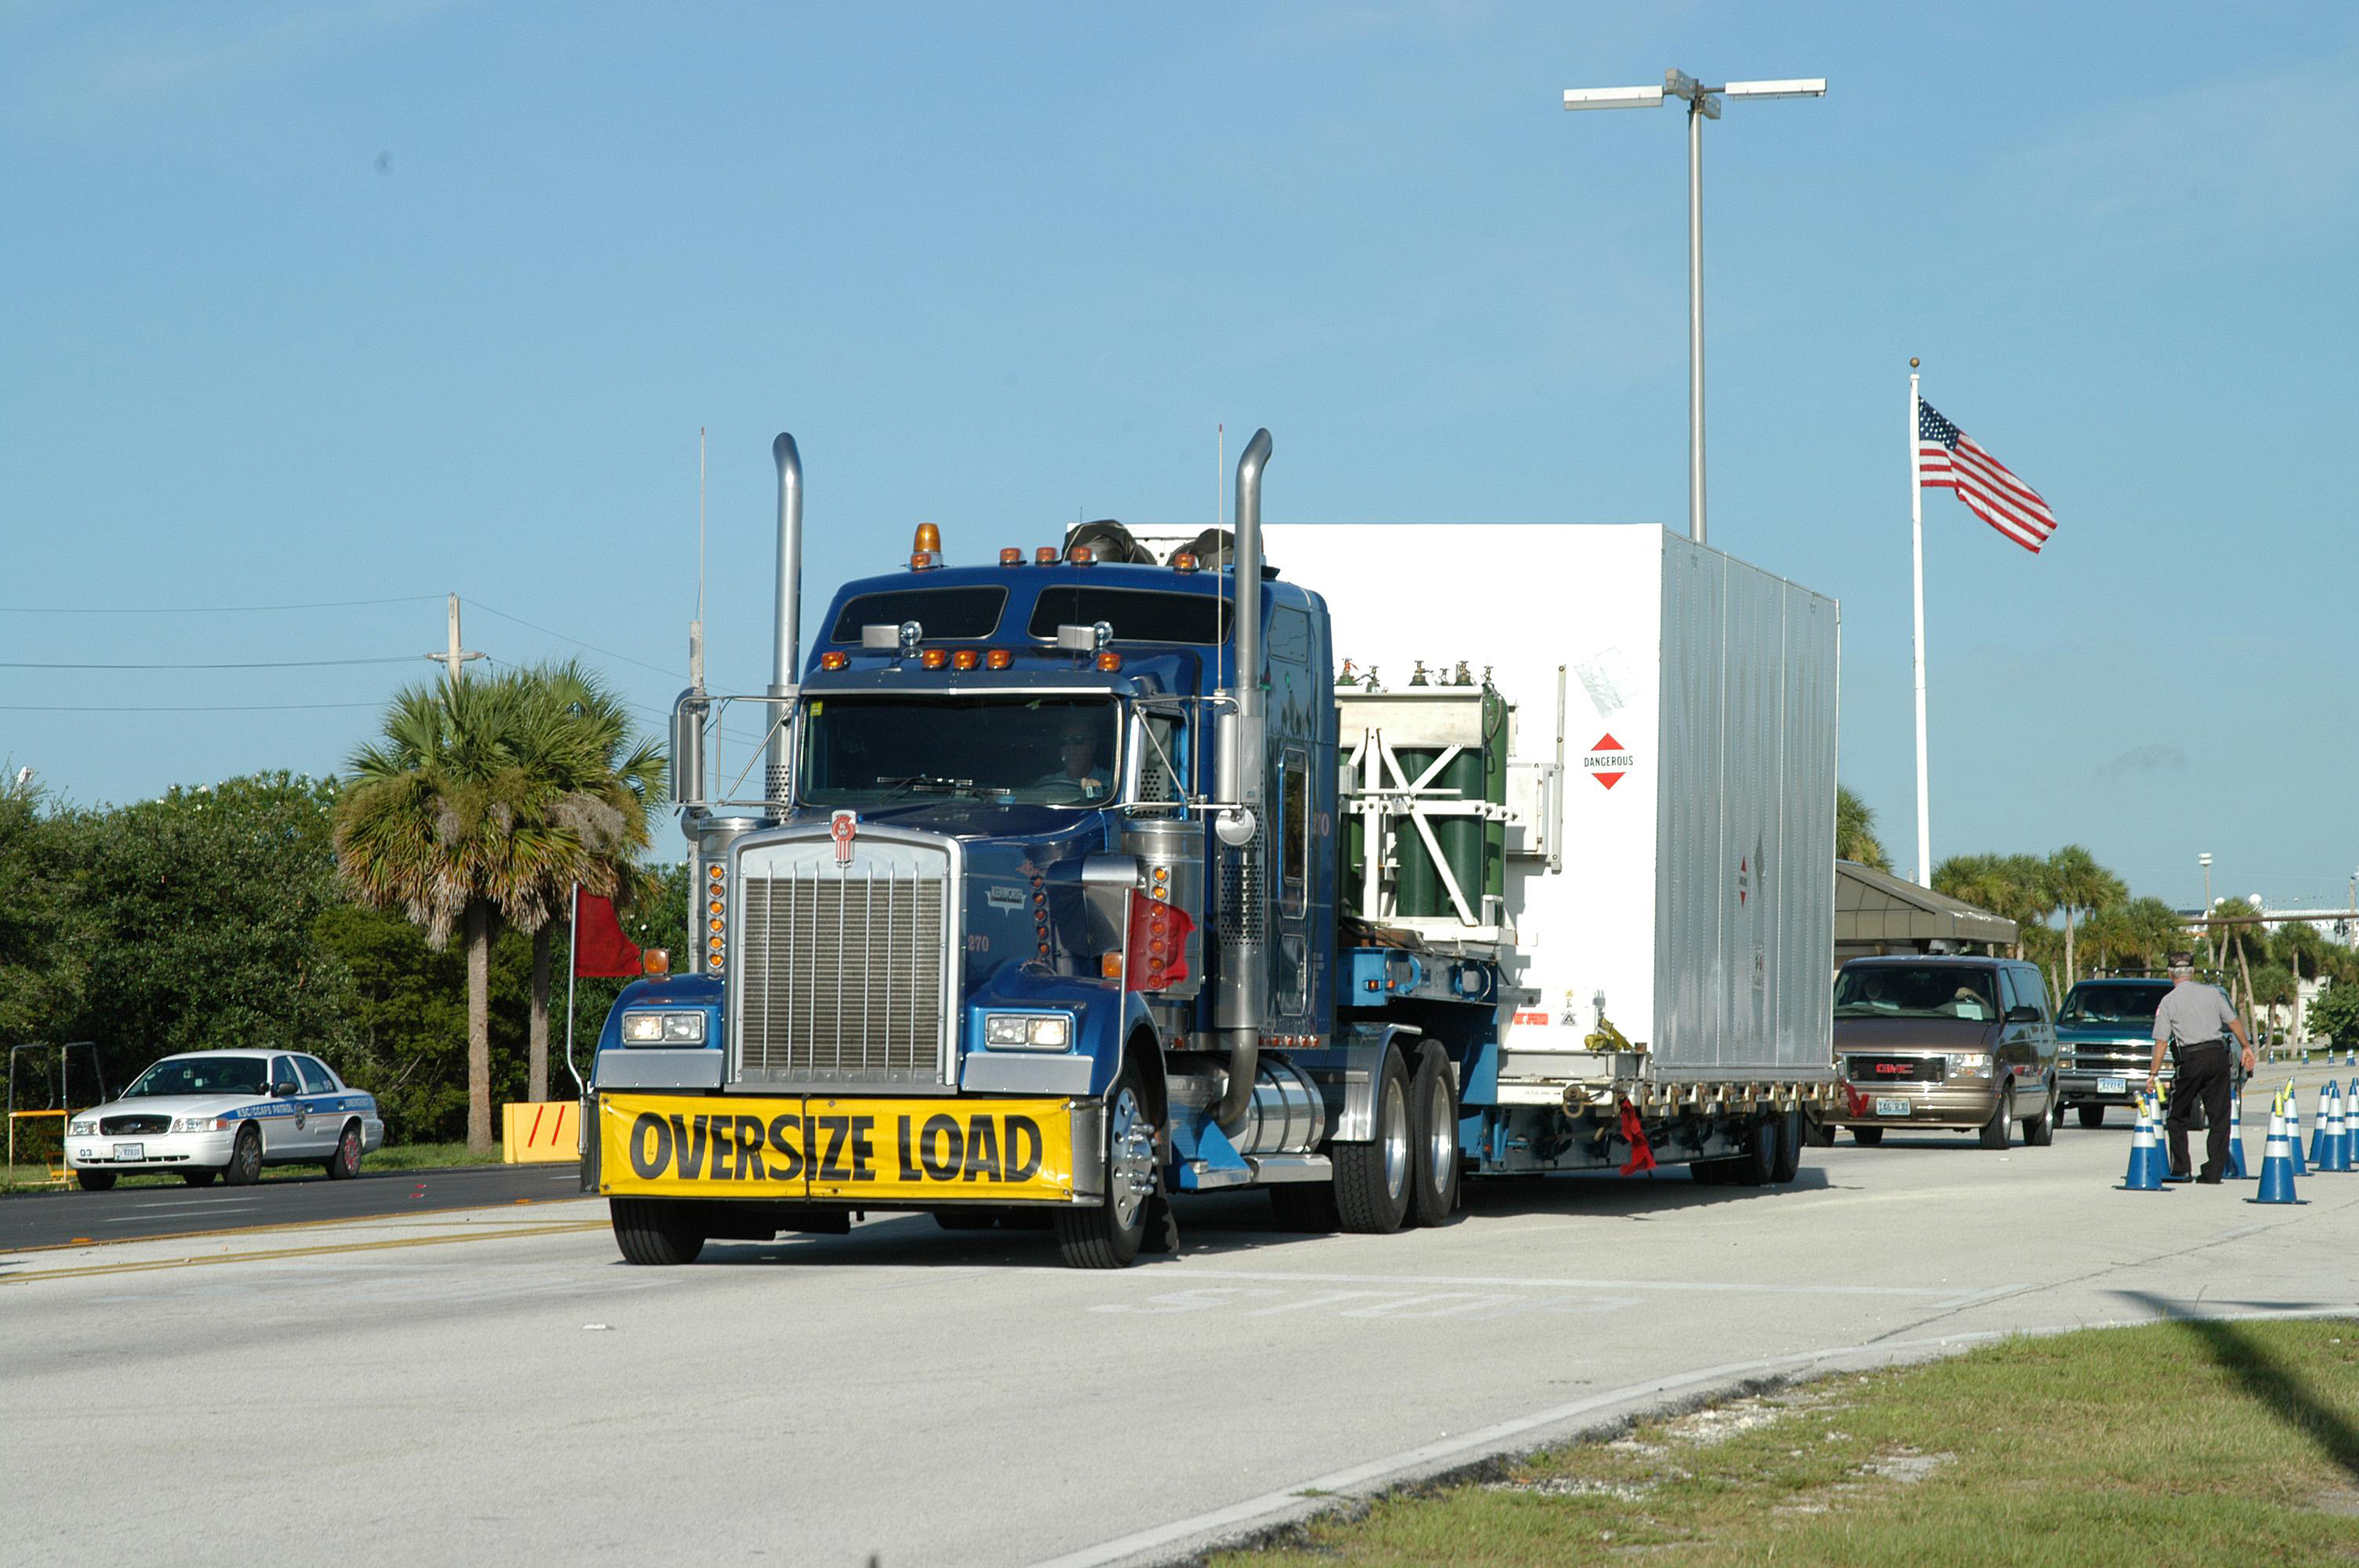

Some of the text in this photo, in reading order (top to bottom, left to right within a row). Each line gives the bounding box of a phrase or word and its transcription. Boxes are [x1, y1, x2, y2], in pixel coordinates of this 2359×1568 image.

[1584, 756, 1634, 767] DANGEROUS
[968, 934, 990, 952] 270
[1876, 1064, 1914, 1074] GMC
[273, 1102, 293, 1114] PATROL
[630, 1112, 1043, 1182] OVERSIZE LOAD
[80, 1149, 93, 1157] 03
